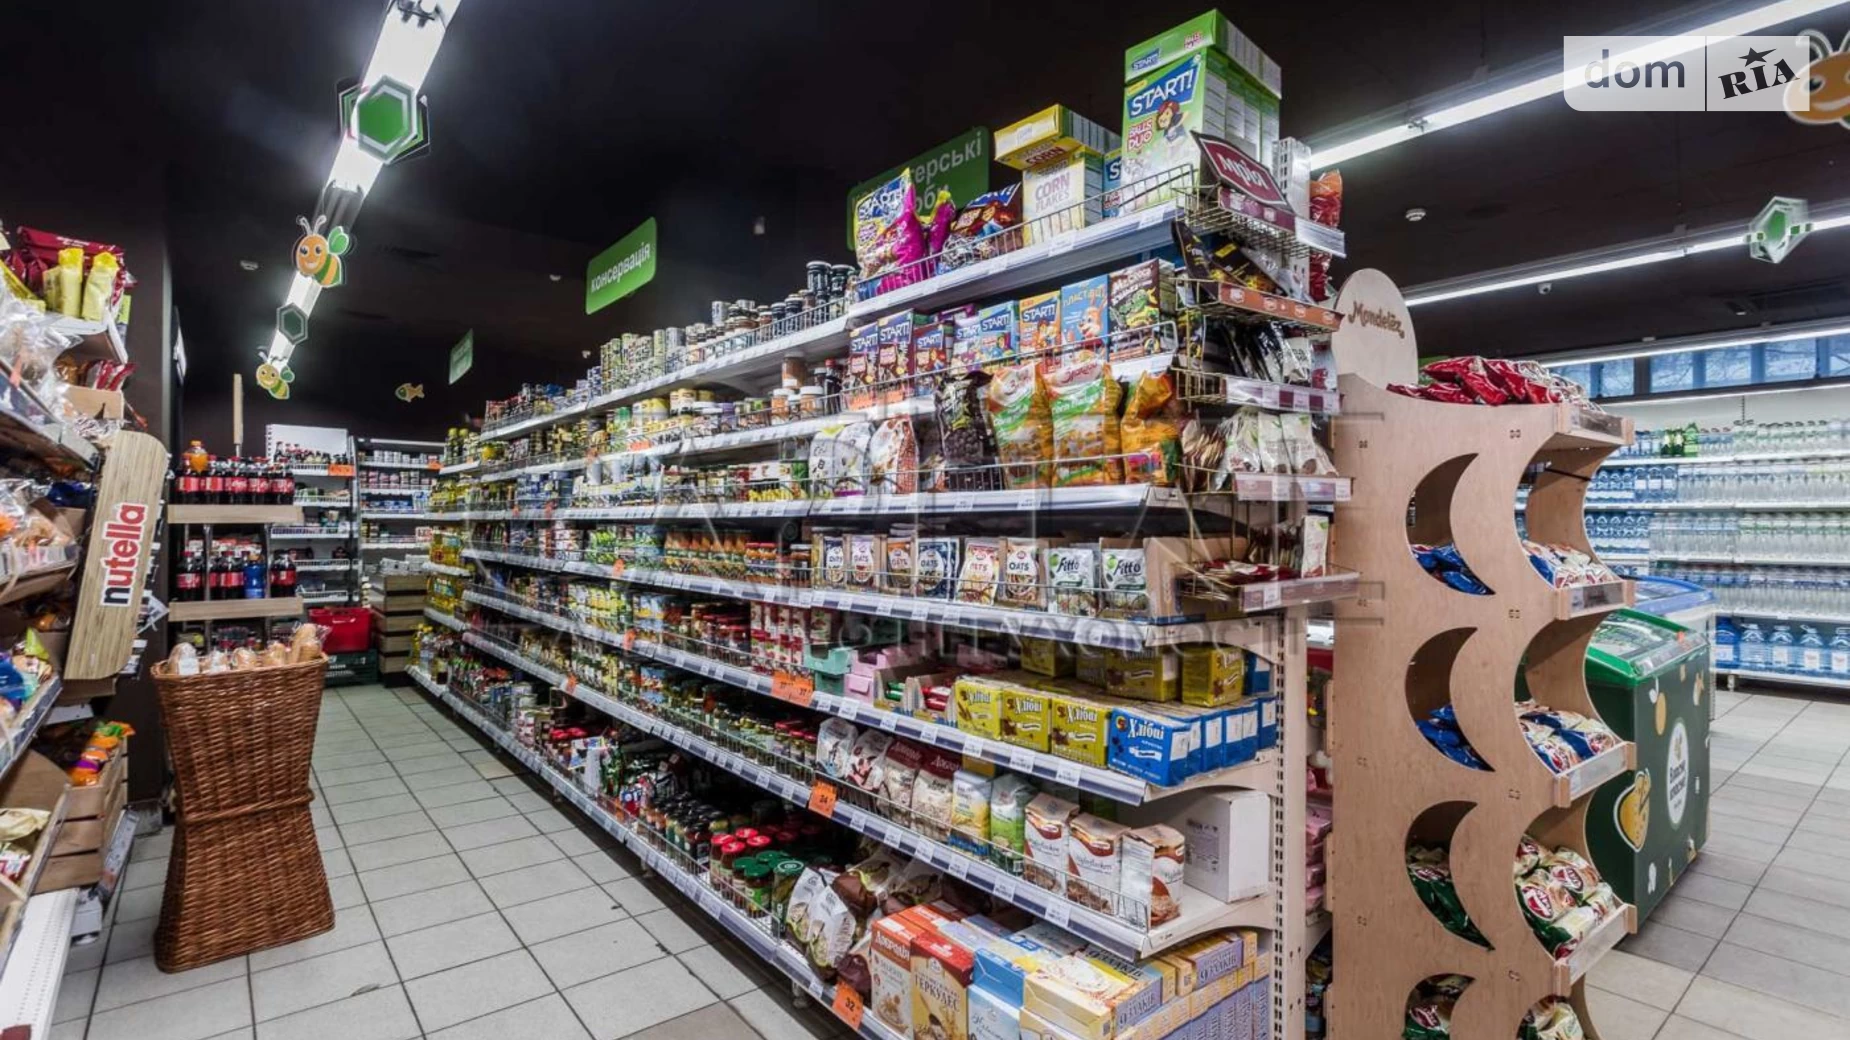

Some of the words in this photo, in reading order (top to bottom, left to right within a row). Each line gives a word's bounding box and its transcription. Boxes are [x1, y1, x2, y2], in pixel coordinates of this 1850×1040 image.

[1130, 67, 1196, 117] START!
[911, 131, 982, 184] ерські
[1035, 171, 1071, 200] CORN
[591, 241, 651, 294] консервація
[982, 313, 1010, 331] START!
[1023, 303, 1056, 323] START!
[880, 320, 910, 341] START!
[103, 504, 146, 605] nutella
[920, 559, 938, 569] OATS
[1055, 556, 1081, 574] Fitto
[1008, 561, 1030, 572] OATS
[1113, 558, 1141, 578] Fitto
[913, 973, 959, 1013] ГЕРКУЛЕС
